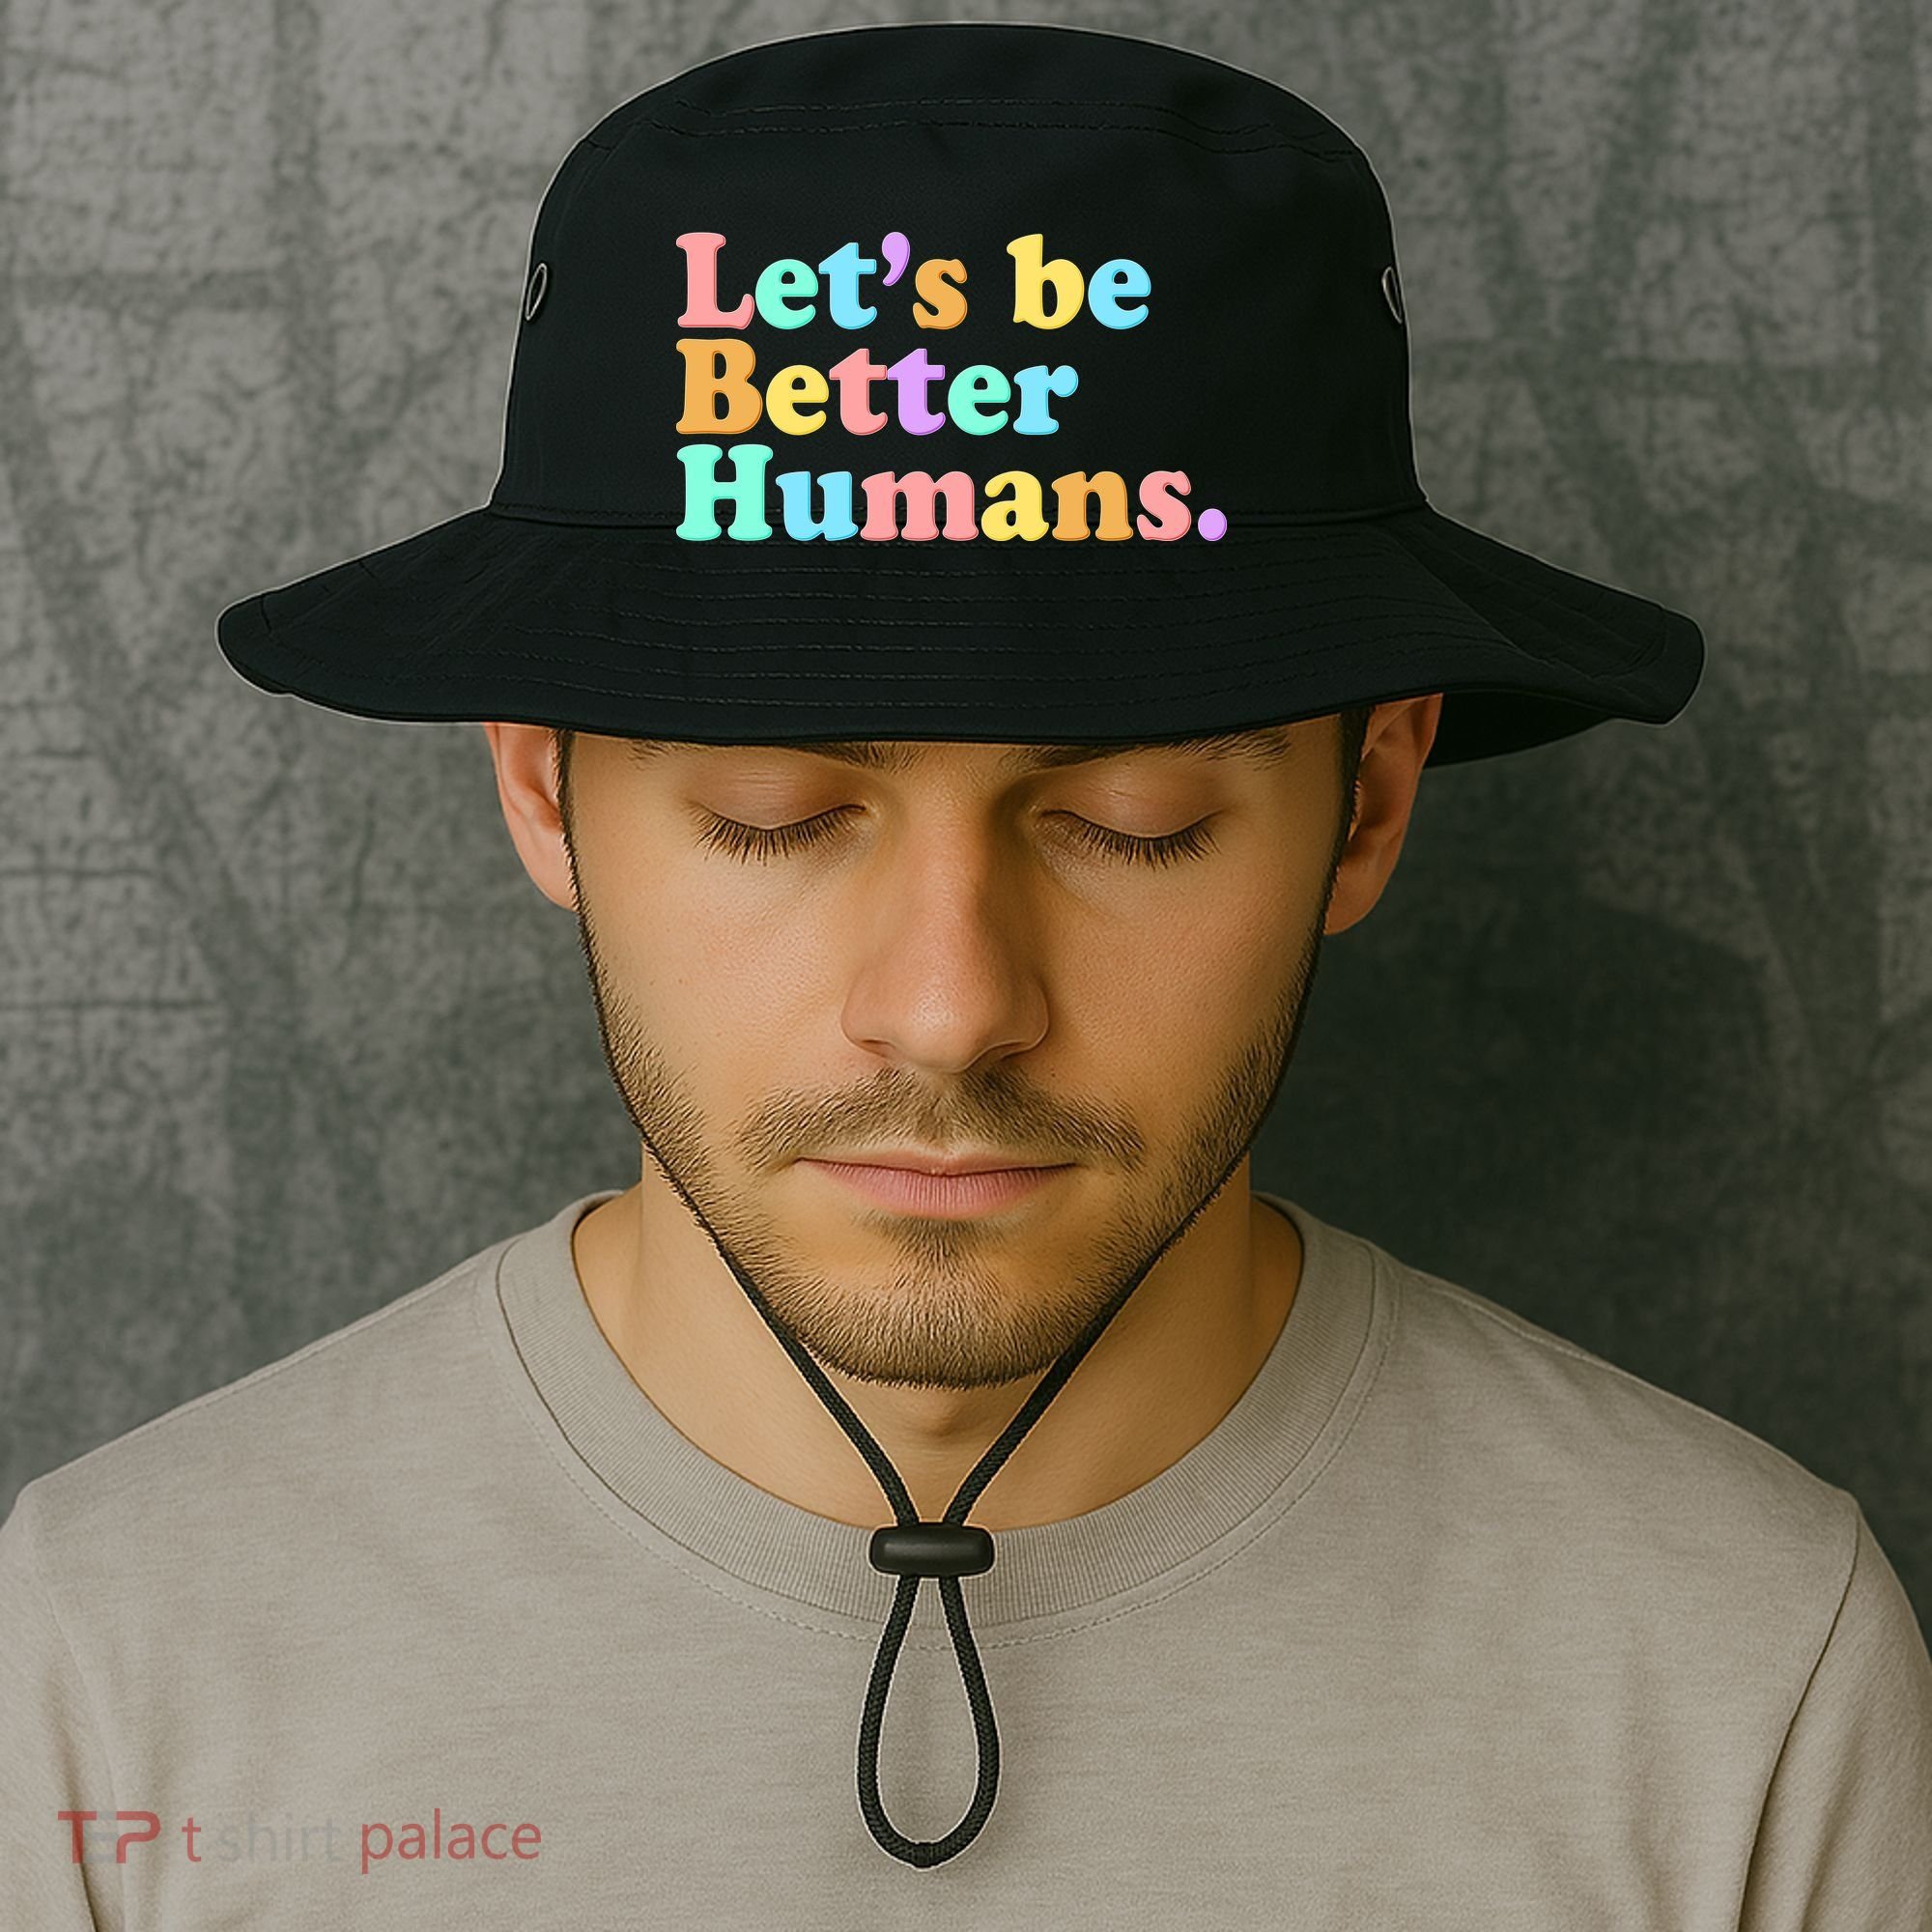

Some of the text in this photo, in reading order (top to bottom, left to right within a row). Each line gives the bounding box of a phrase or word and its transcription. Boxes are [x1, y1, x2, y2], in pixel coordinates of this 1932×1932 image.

[675, 232, 1152, 330] Let’s be
[675, 338, 1079, 436] Better
[675, 443, 1228, 542] Humans.
